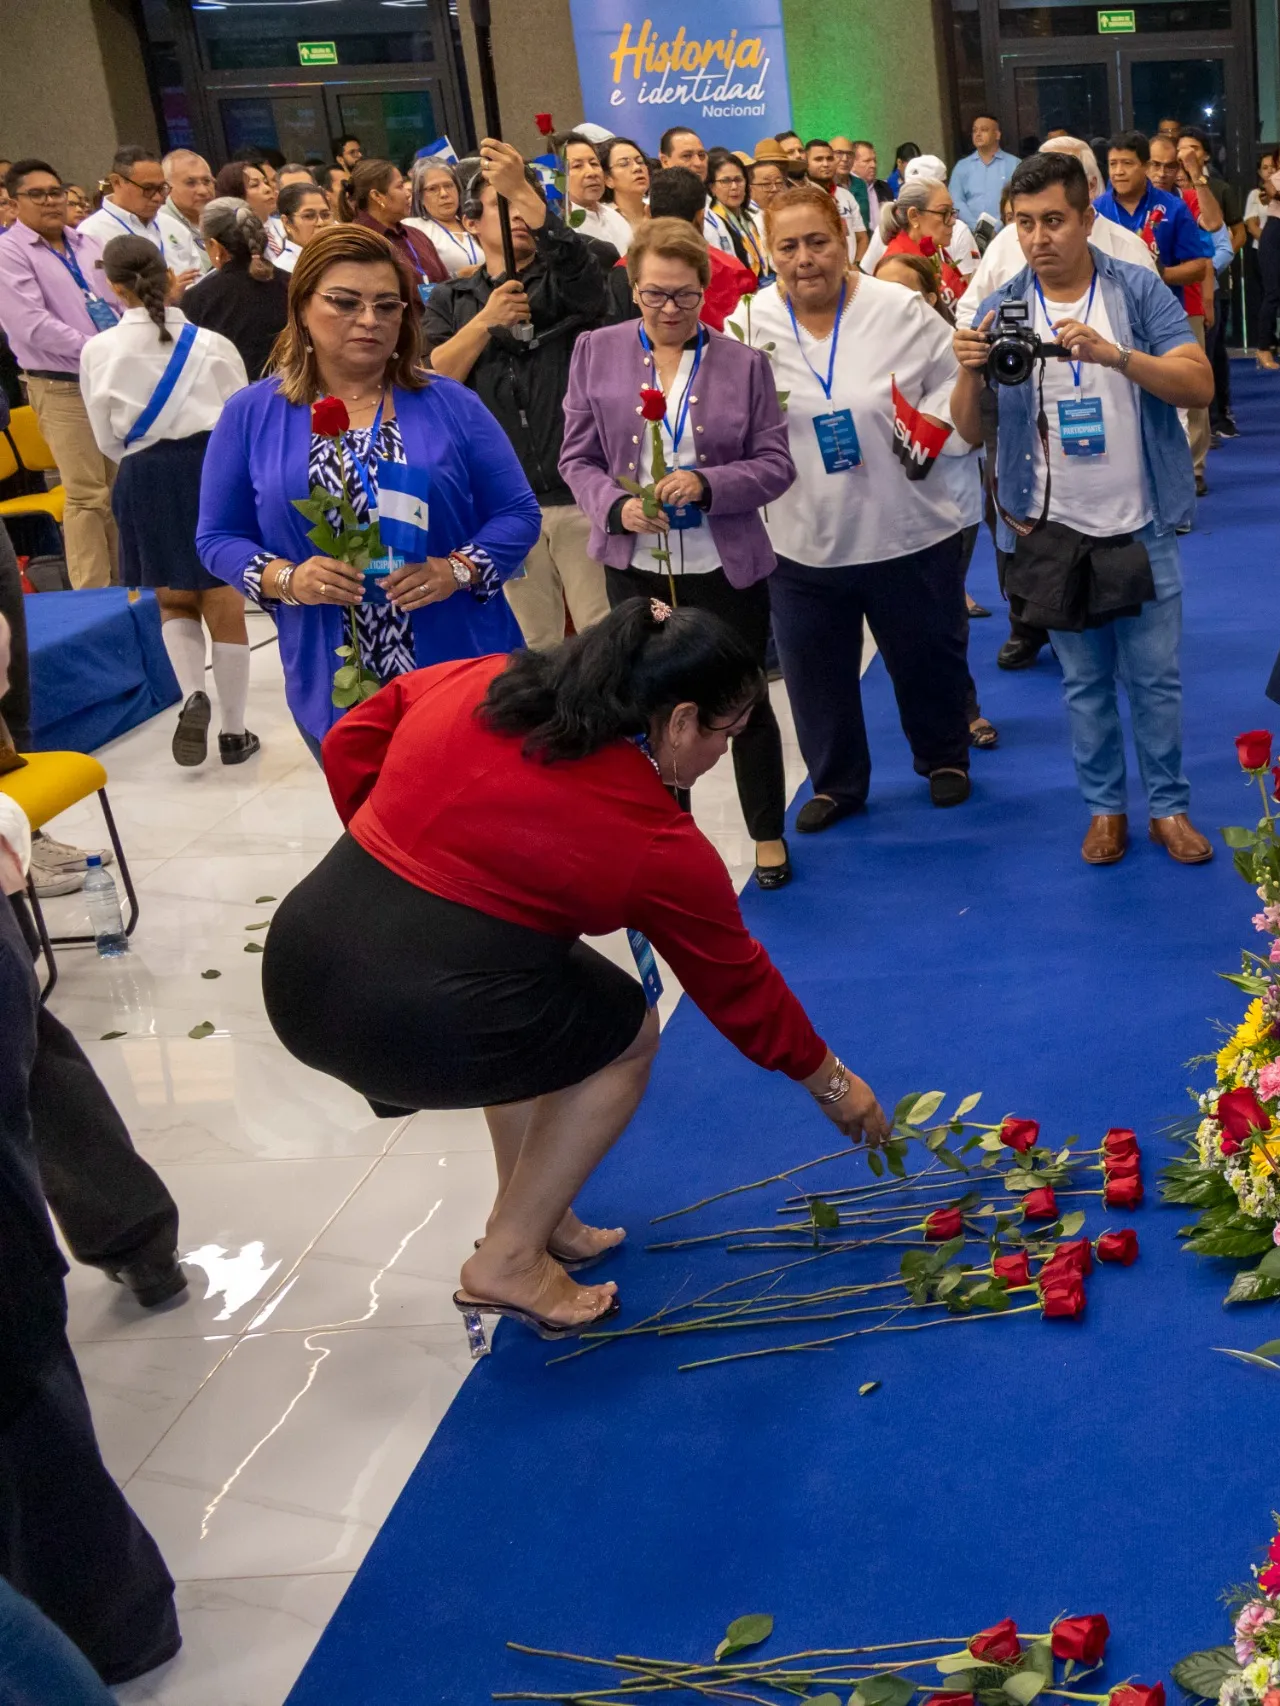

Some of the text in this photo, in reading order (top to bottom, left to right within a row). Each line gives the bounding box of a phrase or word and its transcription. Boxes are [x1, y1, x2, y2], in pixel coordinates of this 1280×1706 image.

[610, 18, 766, 84] Historia
[610, 57, 770, 106] e identidad
[702, 103, 765, 118] Nacional
[893, 404, 931, 466] SLN
